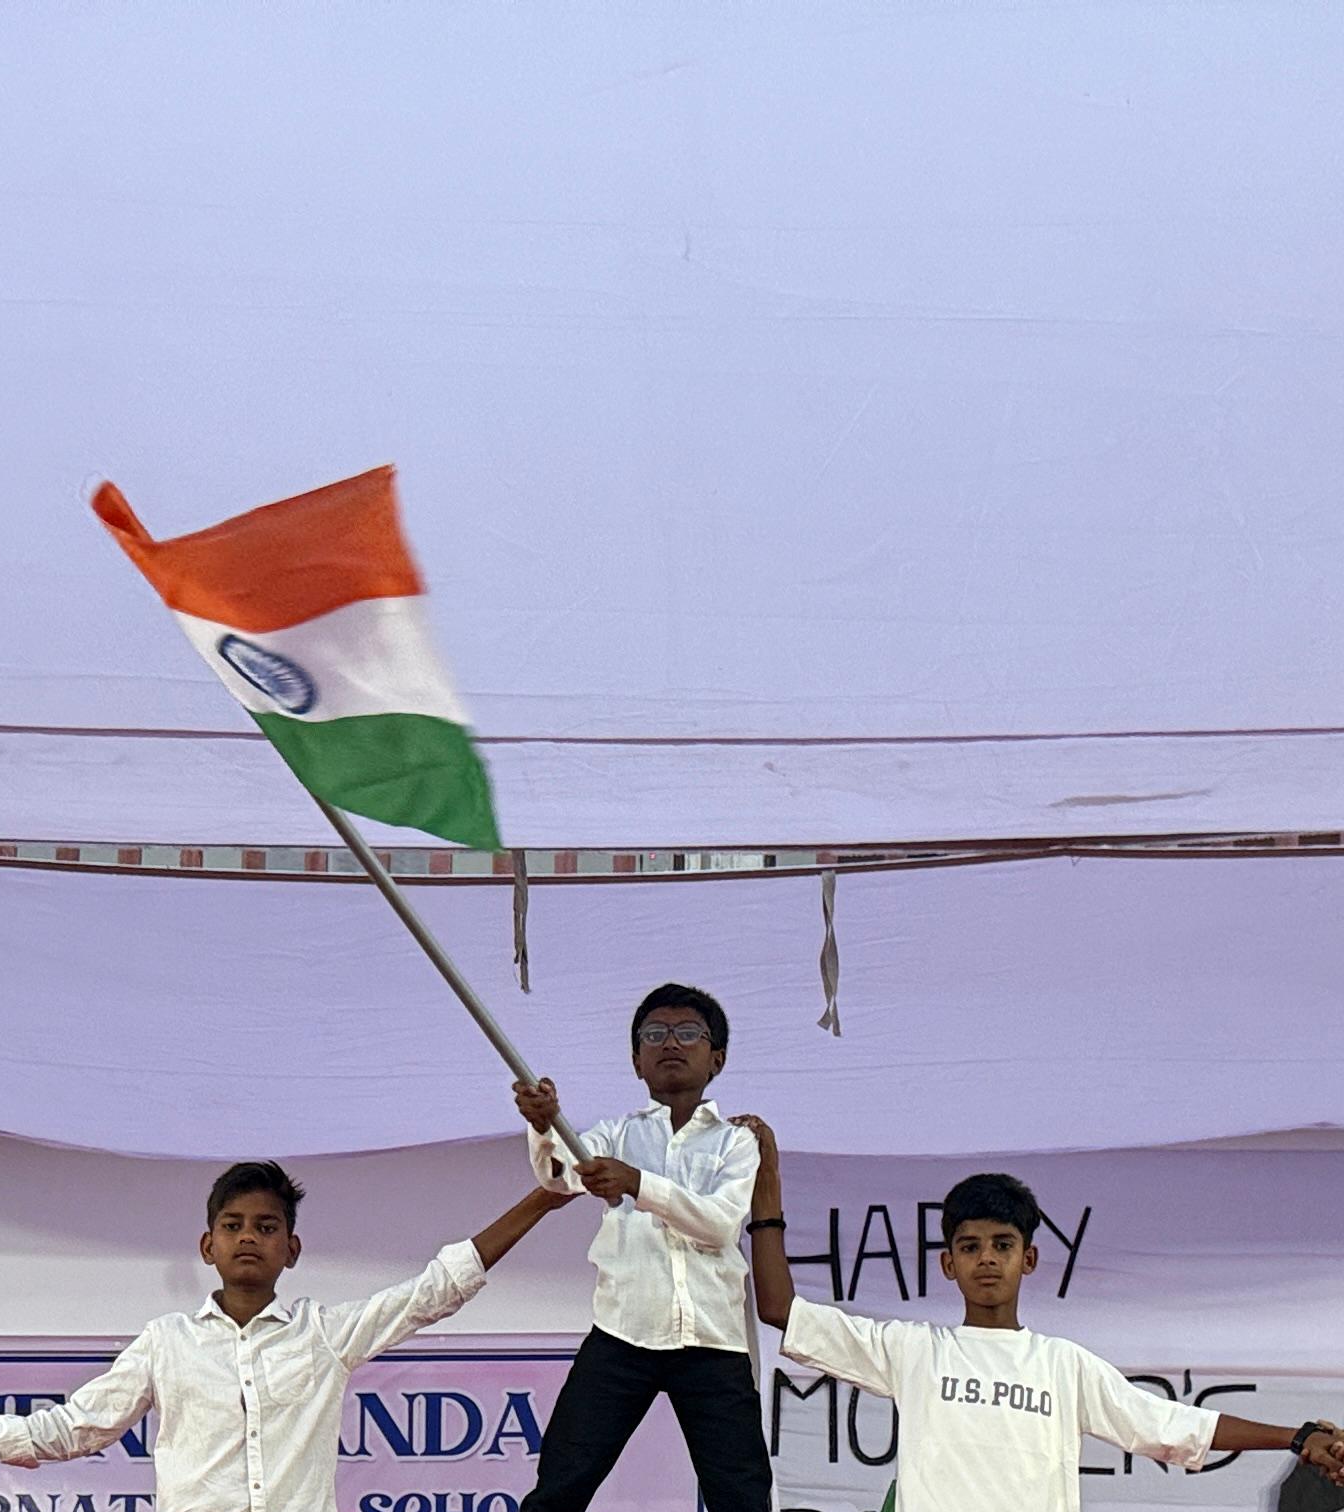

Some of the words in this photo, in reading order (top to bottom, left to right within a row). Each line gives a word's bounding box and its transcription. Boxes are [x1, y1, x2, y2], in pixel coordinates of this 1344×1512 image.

[787, 1203, 1092, 1301] HAPY
[941, 1376, 985, 1404] U.S.
[992, 1382, 1052, 1416] POLO
